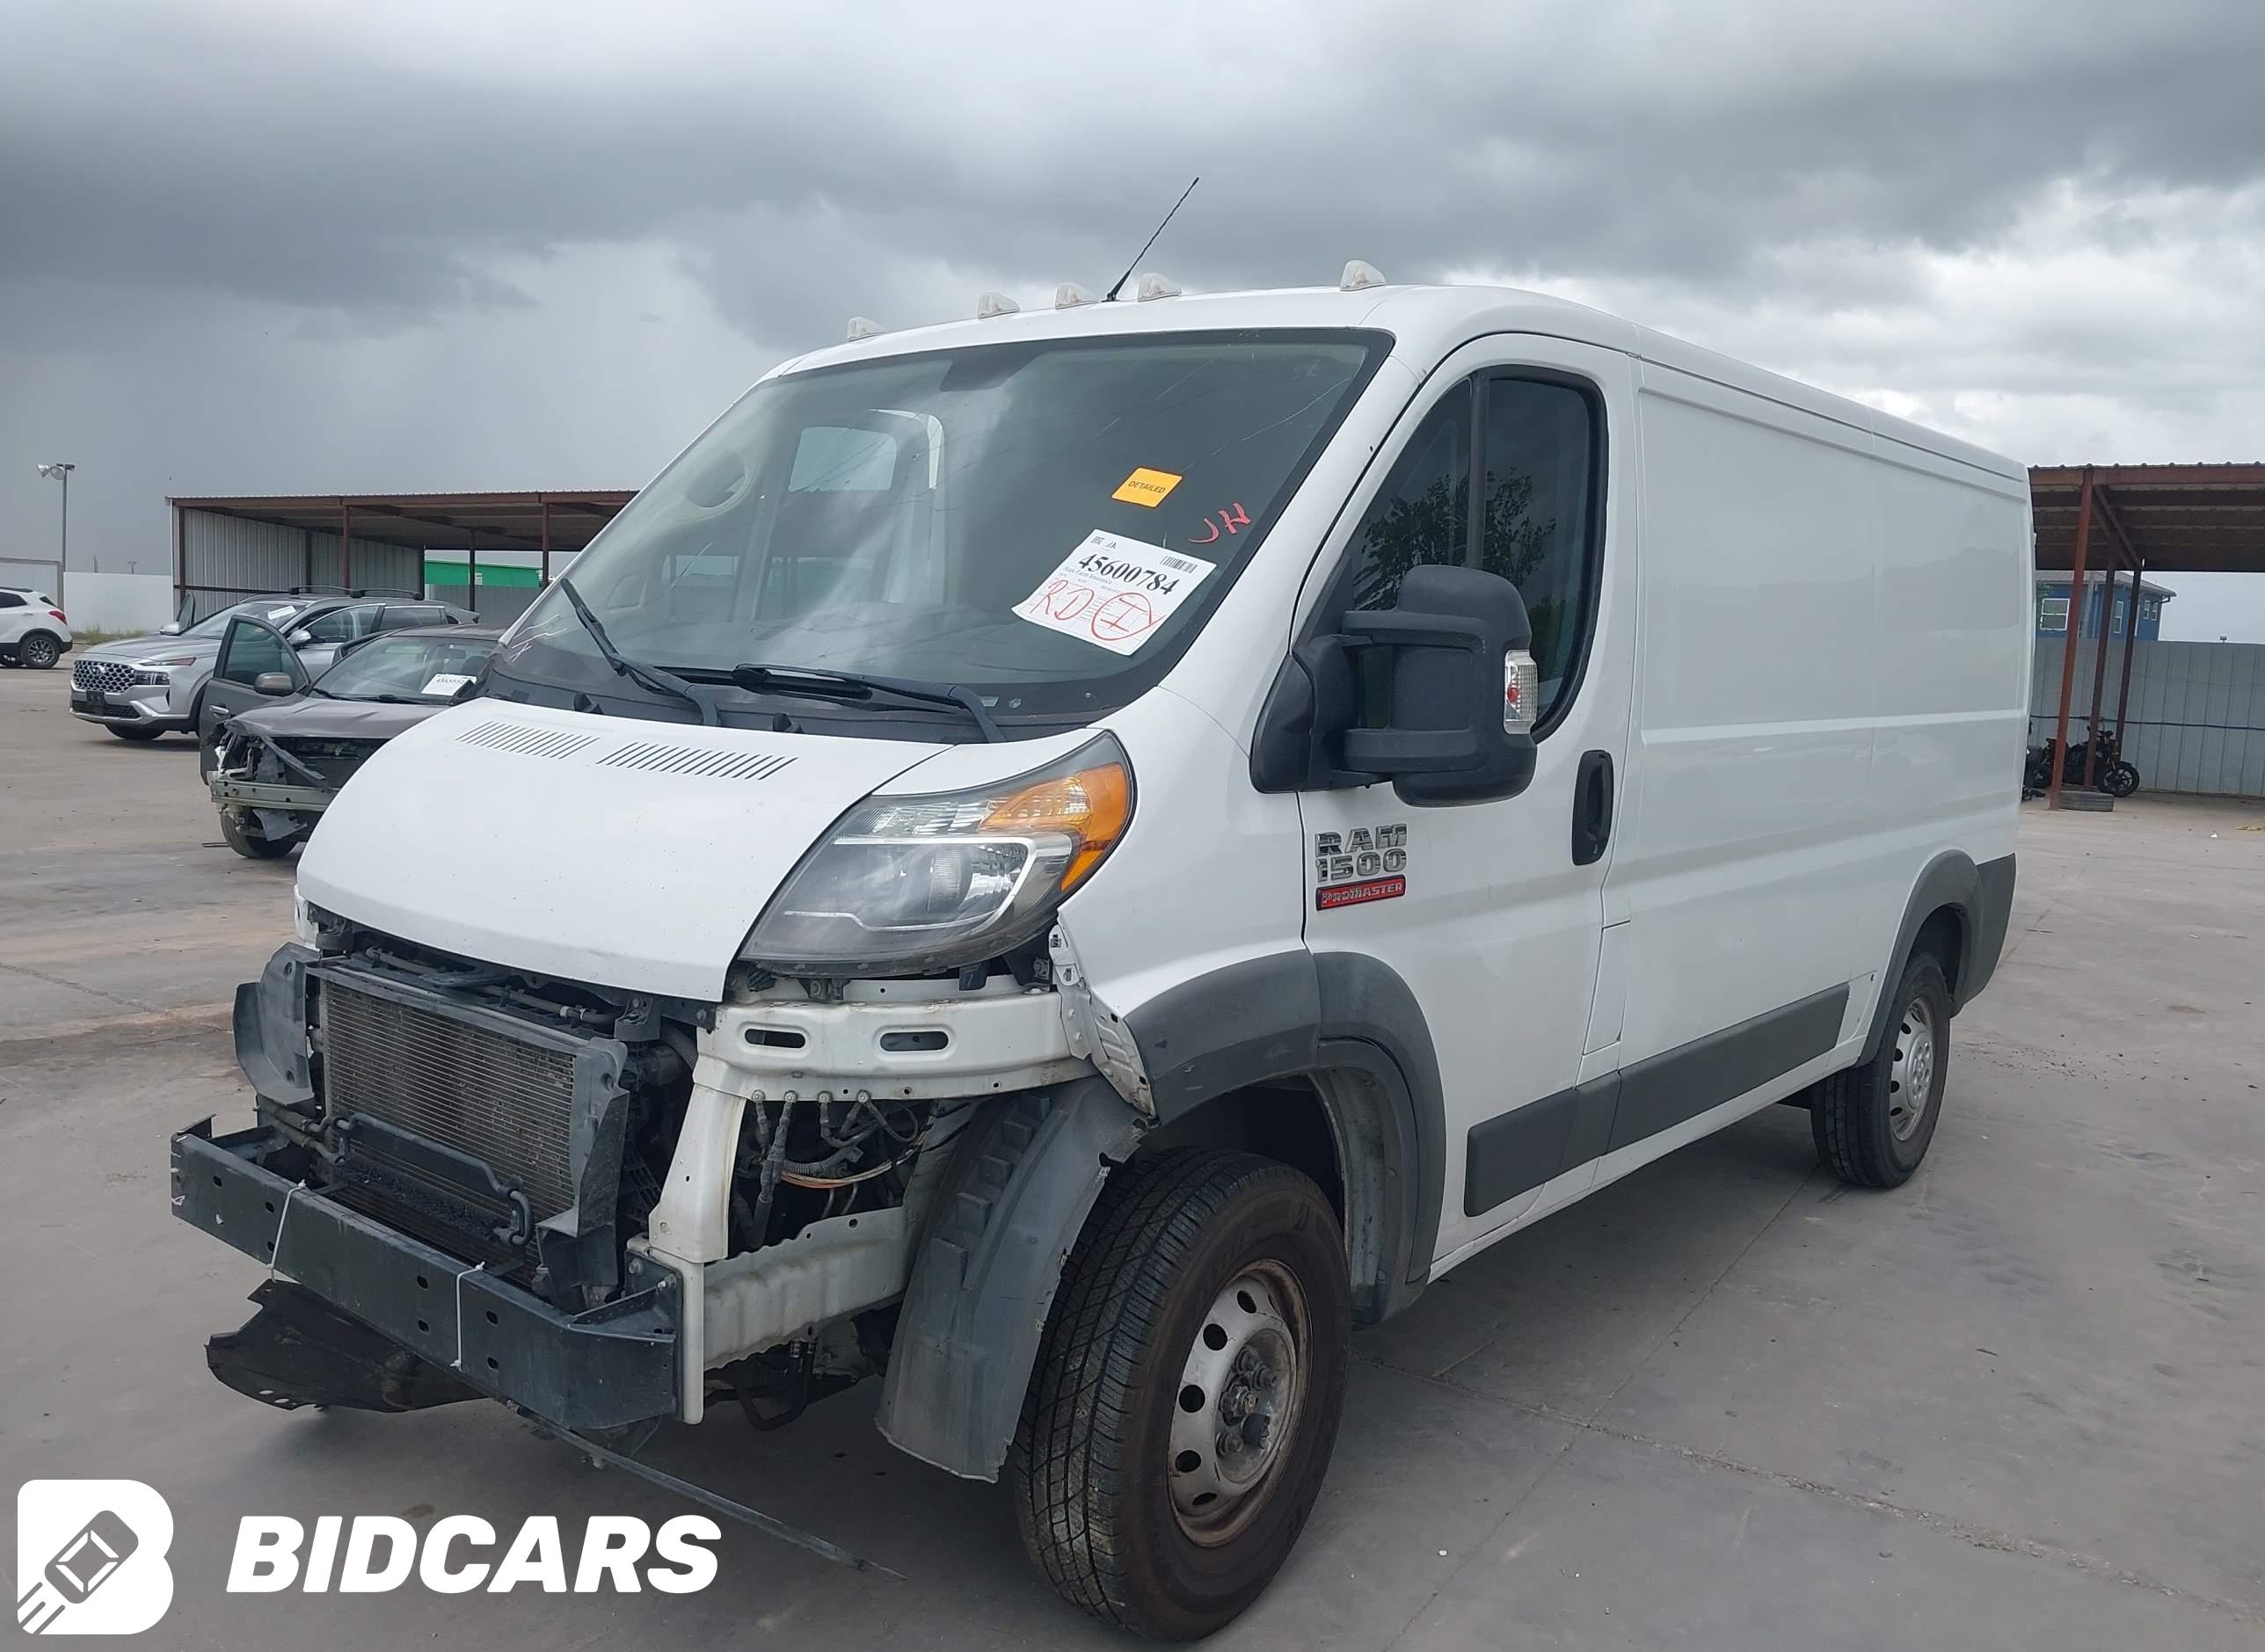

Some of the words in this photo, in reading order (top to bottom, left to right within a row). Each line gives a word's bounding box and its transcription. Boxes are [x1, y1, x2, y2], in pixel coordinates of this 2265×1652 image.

[1127, 480, 1166, 493] DETAILED
[1078, 553, 1180, 595] 45600784
[1315, 823, 1407, 857] RAM
[1315, 848, 1407, 883] 1500
[1322, 883, 1403, 905] PROMASTER
